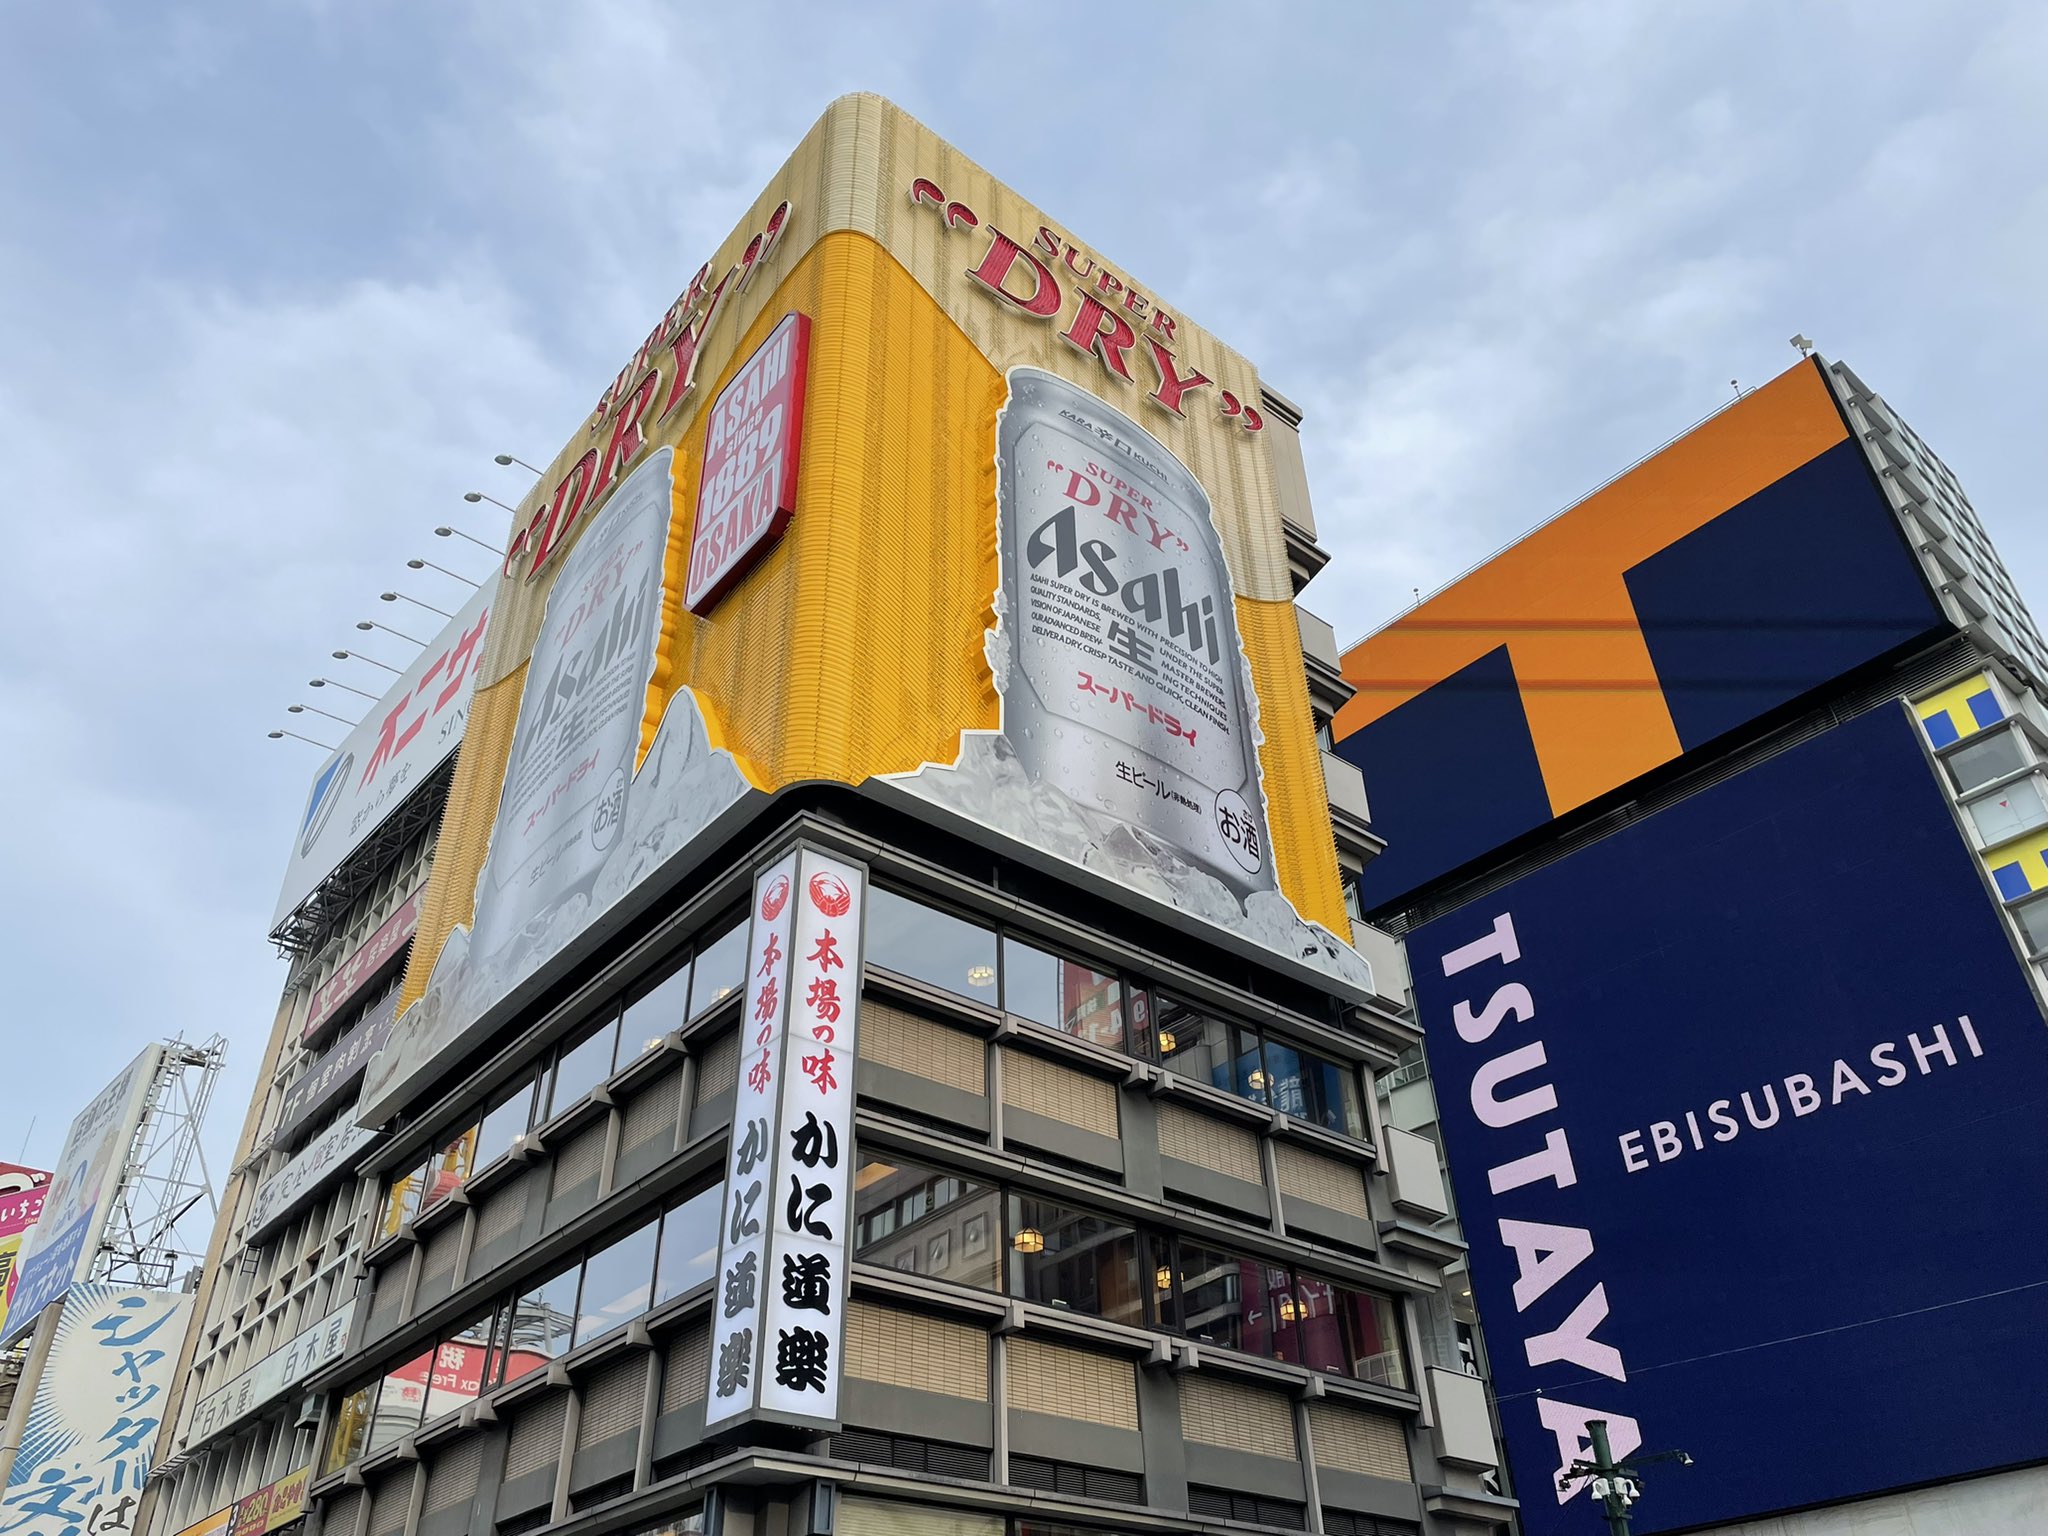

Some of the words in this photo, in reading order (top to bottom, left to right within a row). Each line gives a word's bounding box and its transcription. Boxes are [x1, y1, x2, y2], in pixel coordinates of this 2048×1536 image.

[1031, 226, 1176, 343] SUPER
[706, 329, 790, 463] ASAHI
[700, 402, 783, 531] 1889
[1085, 461, 1153, 511] SUPER
[690, 462, 775, 596] OSAKA
[1026, 505, 1220, 666] Asahi
[1050, 579, 1073, 595] SUPER
[1074, 590, 1091, 603] DRY
[1091, 599, 1100, 608] IS
[1101, 603, 1135, 626] BREWED
[1136, 622, 1159, 640] WITH
[1160, 636, 1197, 666] PRECISION
[1199, 661, 1208, 673] TO
[520, 566, 650, 764] Asahi
[1030, 598, 1052, 612] VISION
[1061, 610, 1102, 633] JAPANESE
[1161, 660, 1197, 686] MASTER
[1083, 644, 1107, 660] CRISP
[1108, 655, 1134, 675] TASTE
[1134, 671, 1155, 686] AND
[1107, 620, 1159, 676] 生
[1159, 647, 1188, 670] UNDER
[1188, 666, 1202, 680] THE
[1162, 672, 1179, 689] ING
[1077, 671, 1197, 747] スーパードライ
[748, 931, 782, 1096] 本場の味
[800, 927, 845, 1096] 本場の味
[1618, 1014, 1984, 1173] EBISUBASHI
[1441, 911, 1642, 1506] TSUTAYA
[281, 1307, 343, 1388] 白木屋
[201, 1368, 251, 1438] 白木屋
